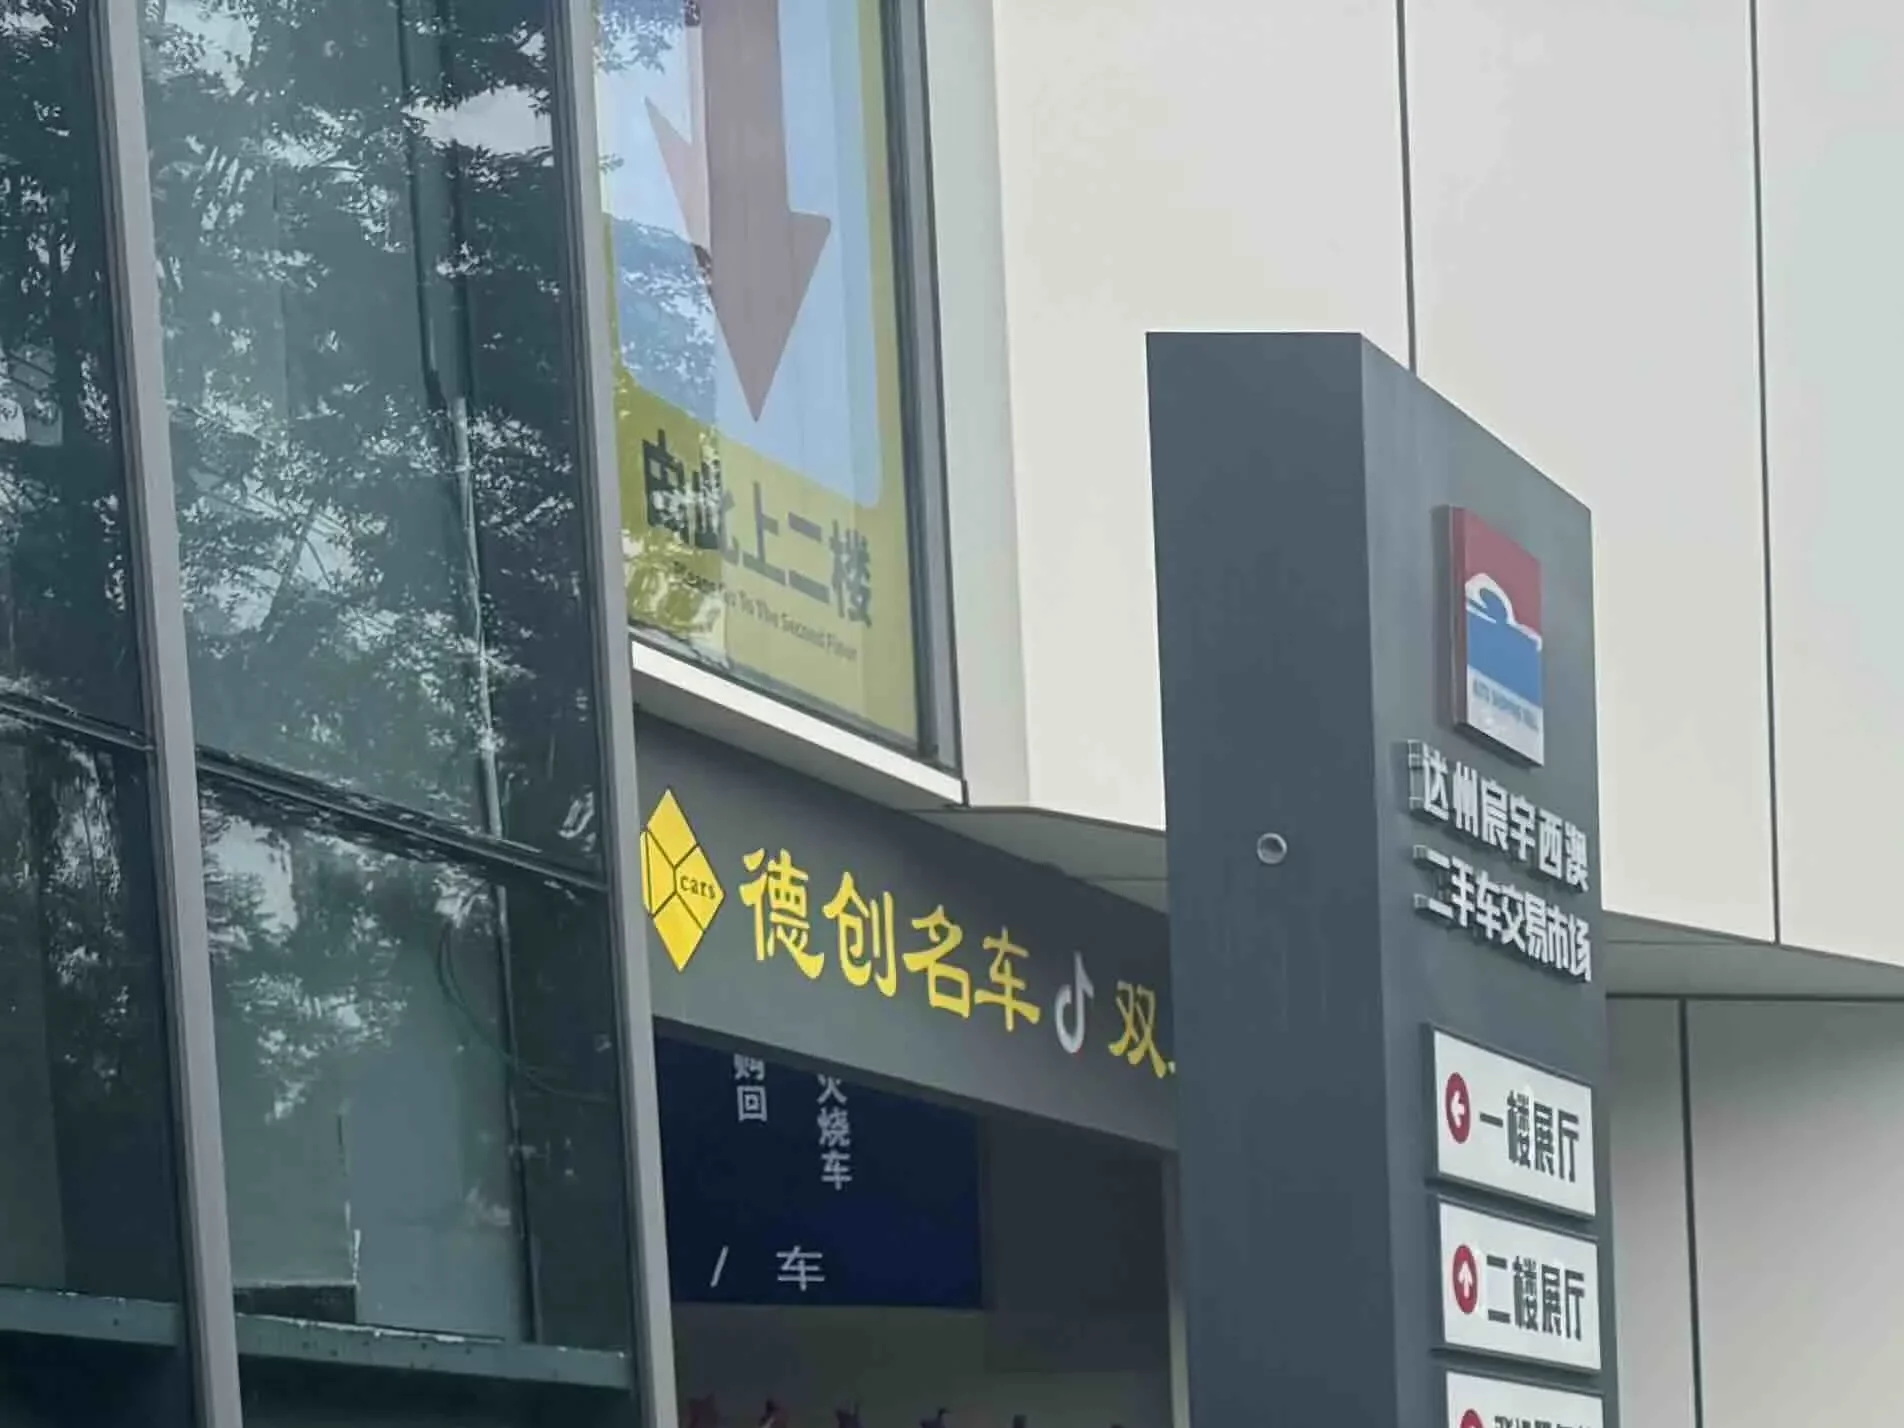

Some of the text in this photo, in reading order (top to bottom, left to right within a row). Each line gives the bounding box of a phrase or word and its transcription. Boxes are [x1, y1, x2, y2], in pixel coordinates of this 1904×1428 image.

[680, 873, 716, 900] cars
[1426, 846, 1592, 982] 二手车交易市场
[738, 848, 1176, 1078] 德创名车 双
[1479, 1090, 1580, 1183] 一楼展厅
[776, 1245, 825, 1291] 车
[1486, 1254, 1586, 1341] 二楼展厅
